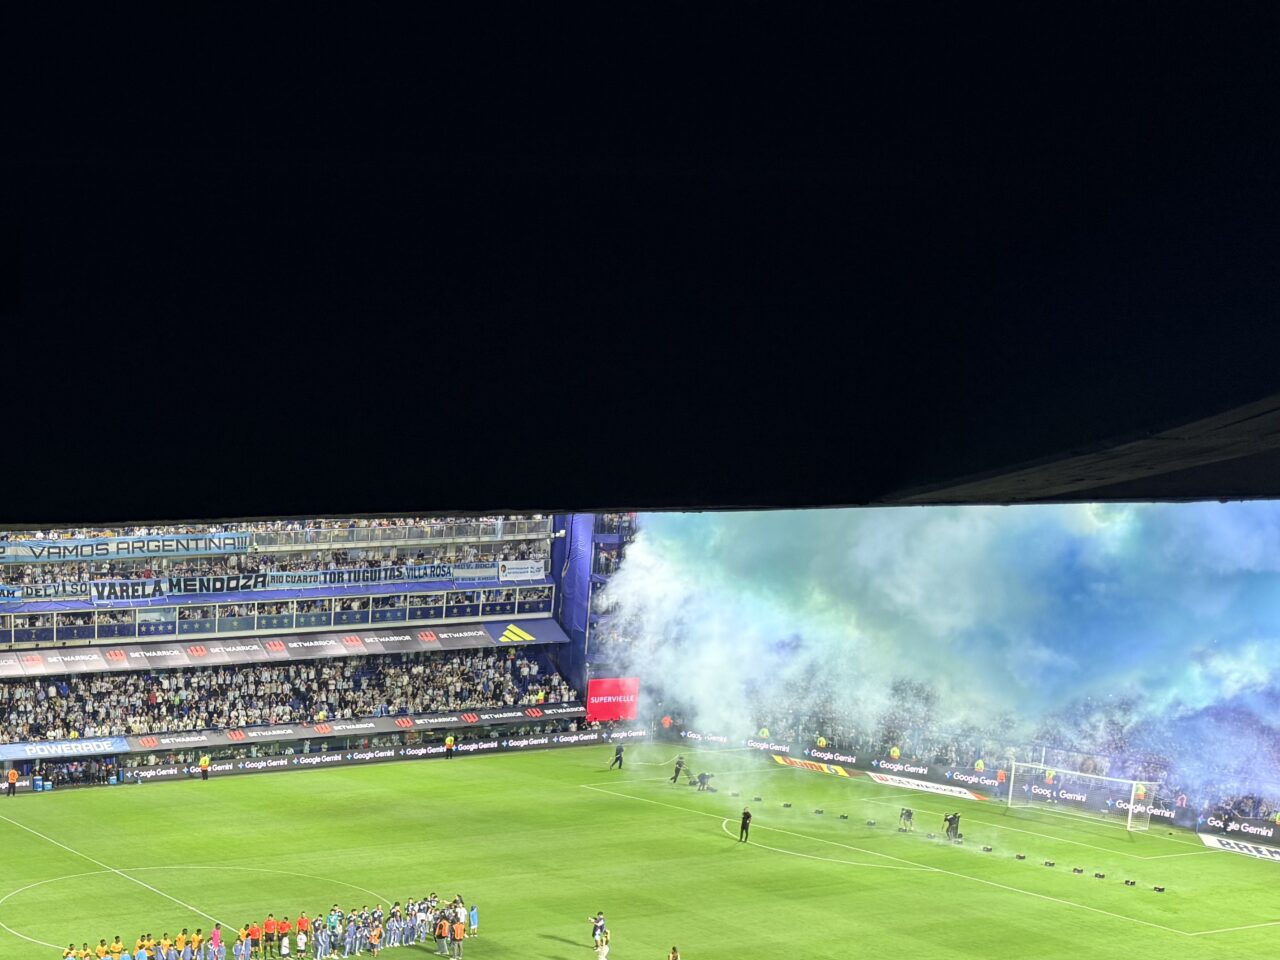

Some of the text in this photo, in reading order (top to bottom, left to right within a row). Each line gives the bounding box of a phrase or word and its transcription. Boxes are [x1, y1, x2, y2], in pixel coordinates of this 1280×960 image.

[29, 542, 110, 559] VAMOS
[406, 564, 452, 579] VILLA ROSA
[170, 573, 268, 593] MENDOZA
[285, 573, 319, 584] CUARTO
[94, 579, 165, 600] VARELA
[130, 649, 181, 658] BETWARRIOR
[210, 644, 260, 654] BETWARRIOR
[590, 695, 634, 704] SUPERVIELLE
[508, 737, 549, 747] Google Gemini
[559, 733, 598, 743] Google Gemini
[25, 741, 114, 756] POWERADE
[458, 741, 498, 752] Google Gemini
[747, 739, 790, 753] Google Gemini
[353, 750, 395, 760] Google Gemini
[406, 748, 427, 756] Google
[811, 749, 857, 764] Google Gemini
[245, 758, 288, 769] Google Gemini
[299, 754, 342, 765] Google Gemini
[156, 767, 178, 776] Gemini
[190, 763, 233, 773] Gooe Gemini
[879, 760, 928, 775] Google Gemini
[953, 772, 980, 784] Google
[1059, 790, 1087, 802] Gemini
[1146, 805, 1176, 819] Gemini
[1240, 823, 1274, 838] Gemini
